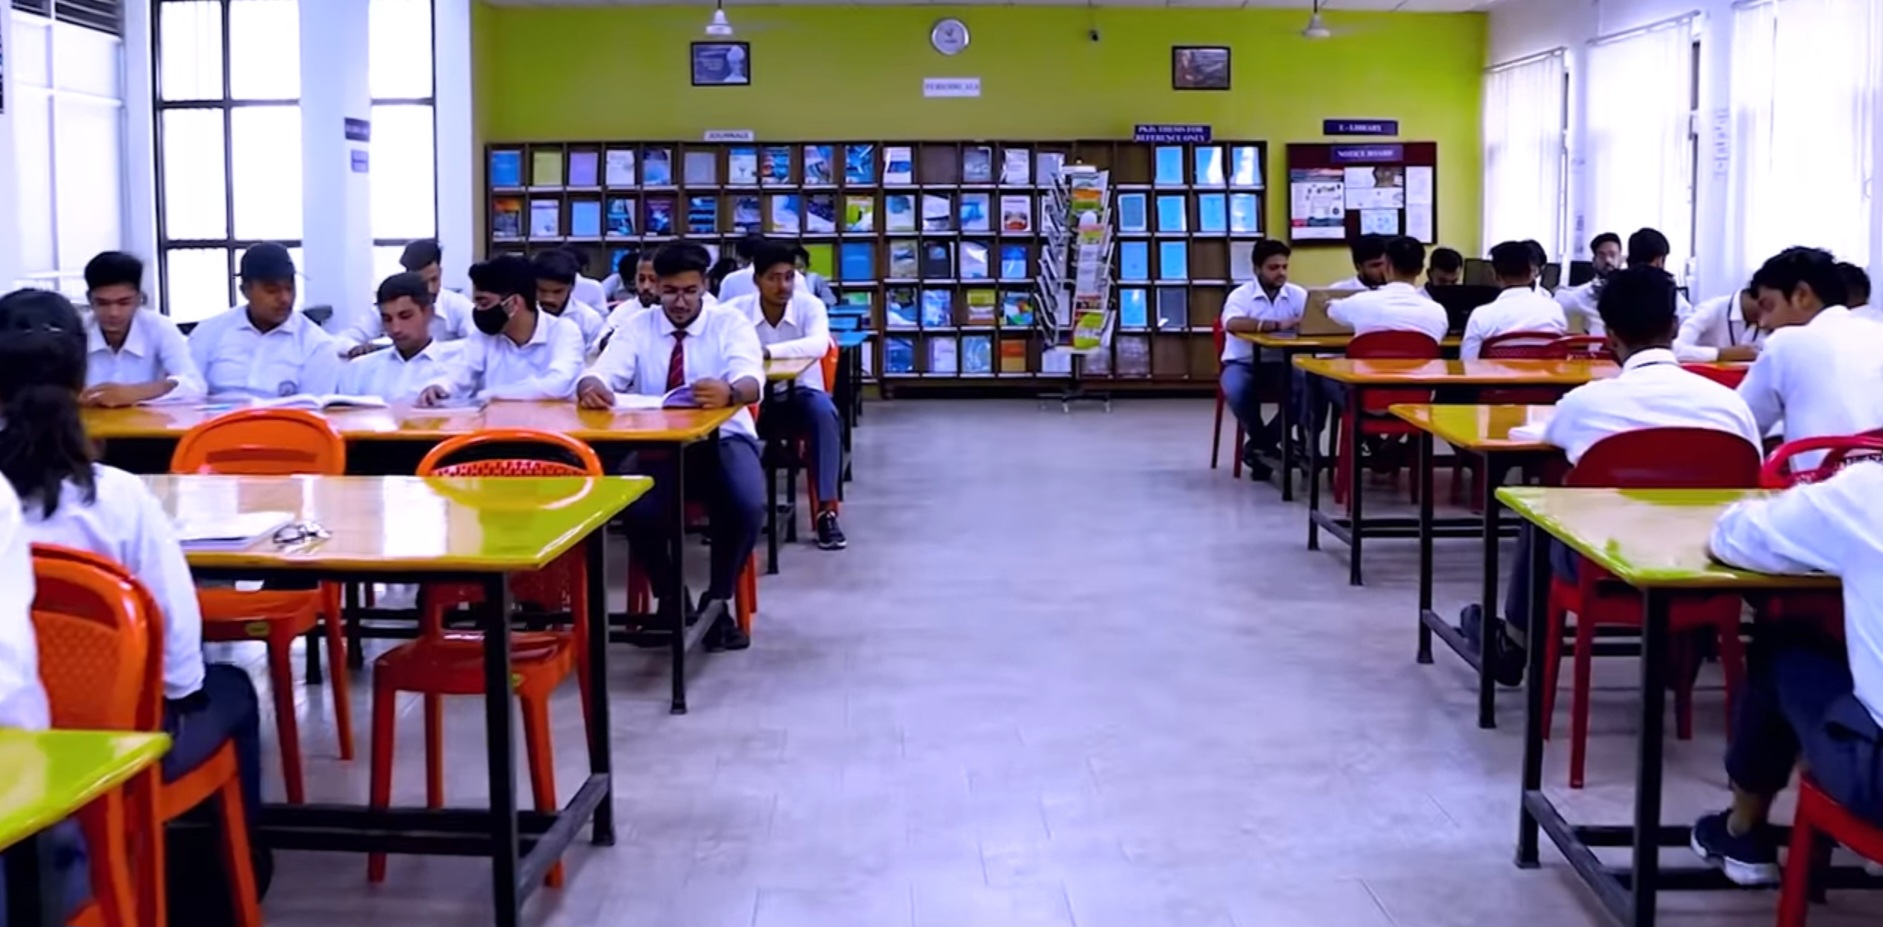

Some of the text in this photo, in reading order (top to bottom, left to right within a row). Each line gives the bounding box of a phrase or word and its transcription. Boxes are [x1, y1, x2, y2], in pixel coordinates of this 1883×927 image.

[1158, 126, 1186, 134] THESIS
[1186, 126, 1204, 134] FOR
[1135, 134, 1205, 142] REFERENCE ONLY
[1337, 150, 1394, 158] NOTICE BOARD
